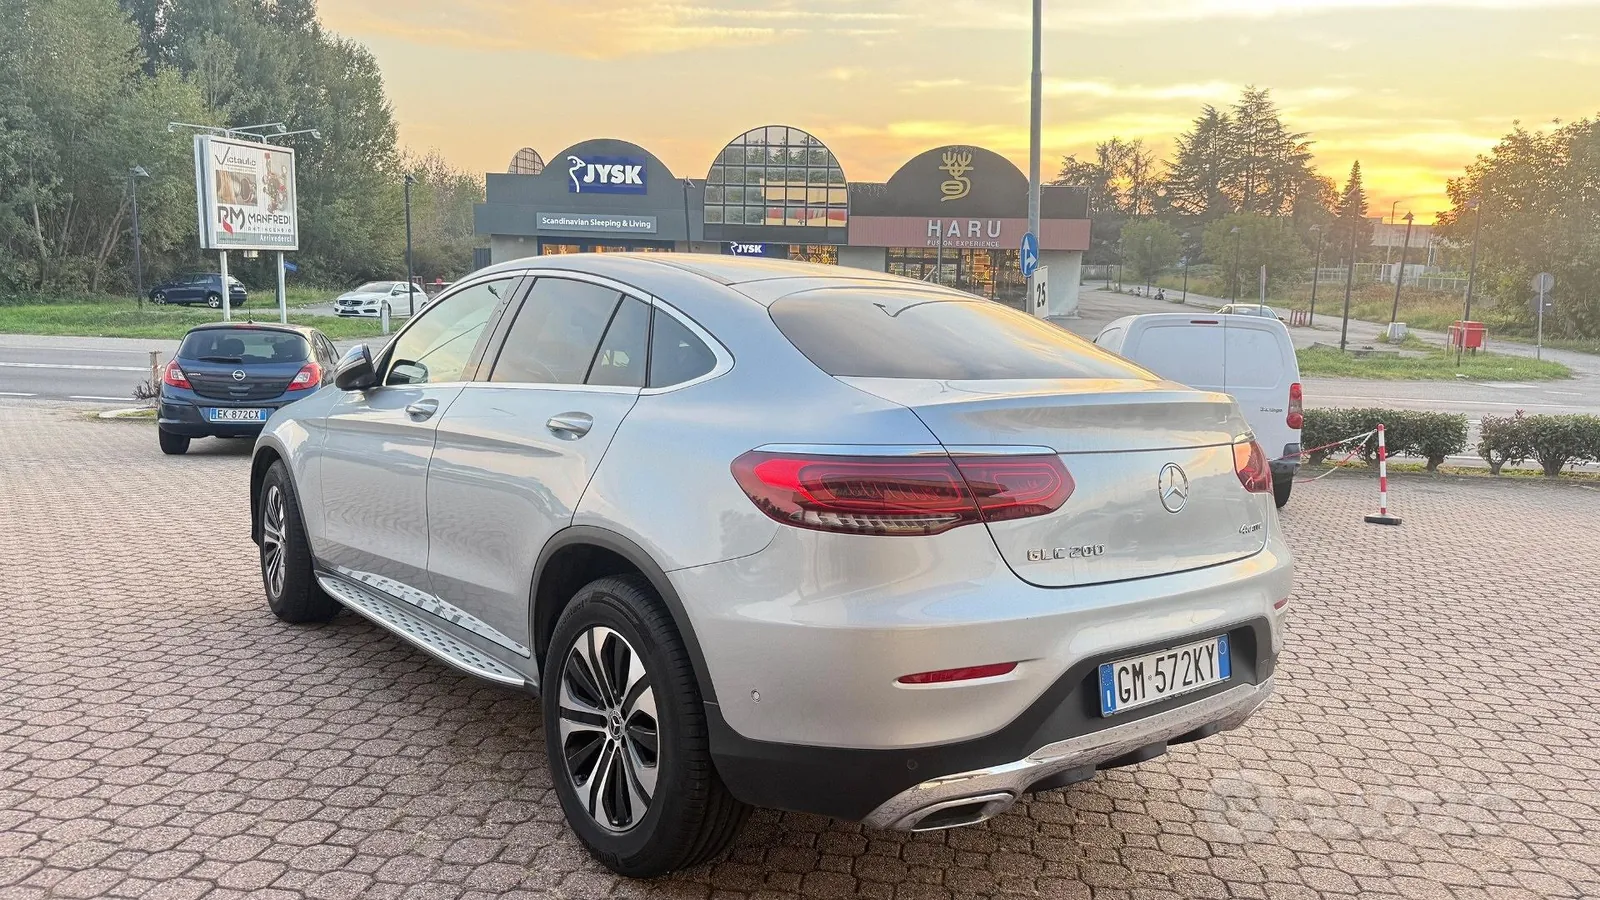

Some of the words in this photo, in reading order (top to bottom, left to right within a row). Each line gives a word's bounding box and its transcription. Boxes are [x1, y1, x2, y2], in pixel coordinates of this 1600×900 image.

[583, 164, 644, 185] JYSK
[217, 206, 245, 230] RM
[248, 213, 291, 225] MANFREDI
[542, 216, 589, 226] Scandinavian
[590, 218, 621, 228] Sleeping
[629, 220, 651, 229] Living
[927, 219, 1001, 238] HARU
[737, 244, 762, 254] JYSK
[956, 240, 1000, 248] EXPERIENCE
[1036, 281, 1046, 308] 25
[217, 410, 228, 419] EK
[232, 410, 260, 419] 872CX
[1027, 547, 1066, 562] GLC
[1069, 544, 1105, 559] 200
[1117, 661, 1146, 704] GM
[1155, 643, 1216, 694] 572KY
